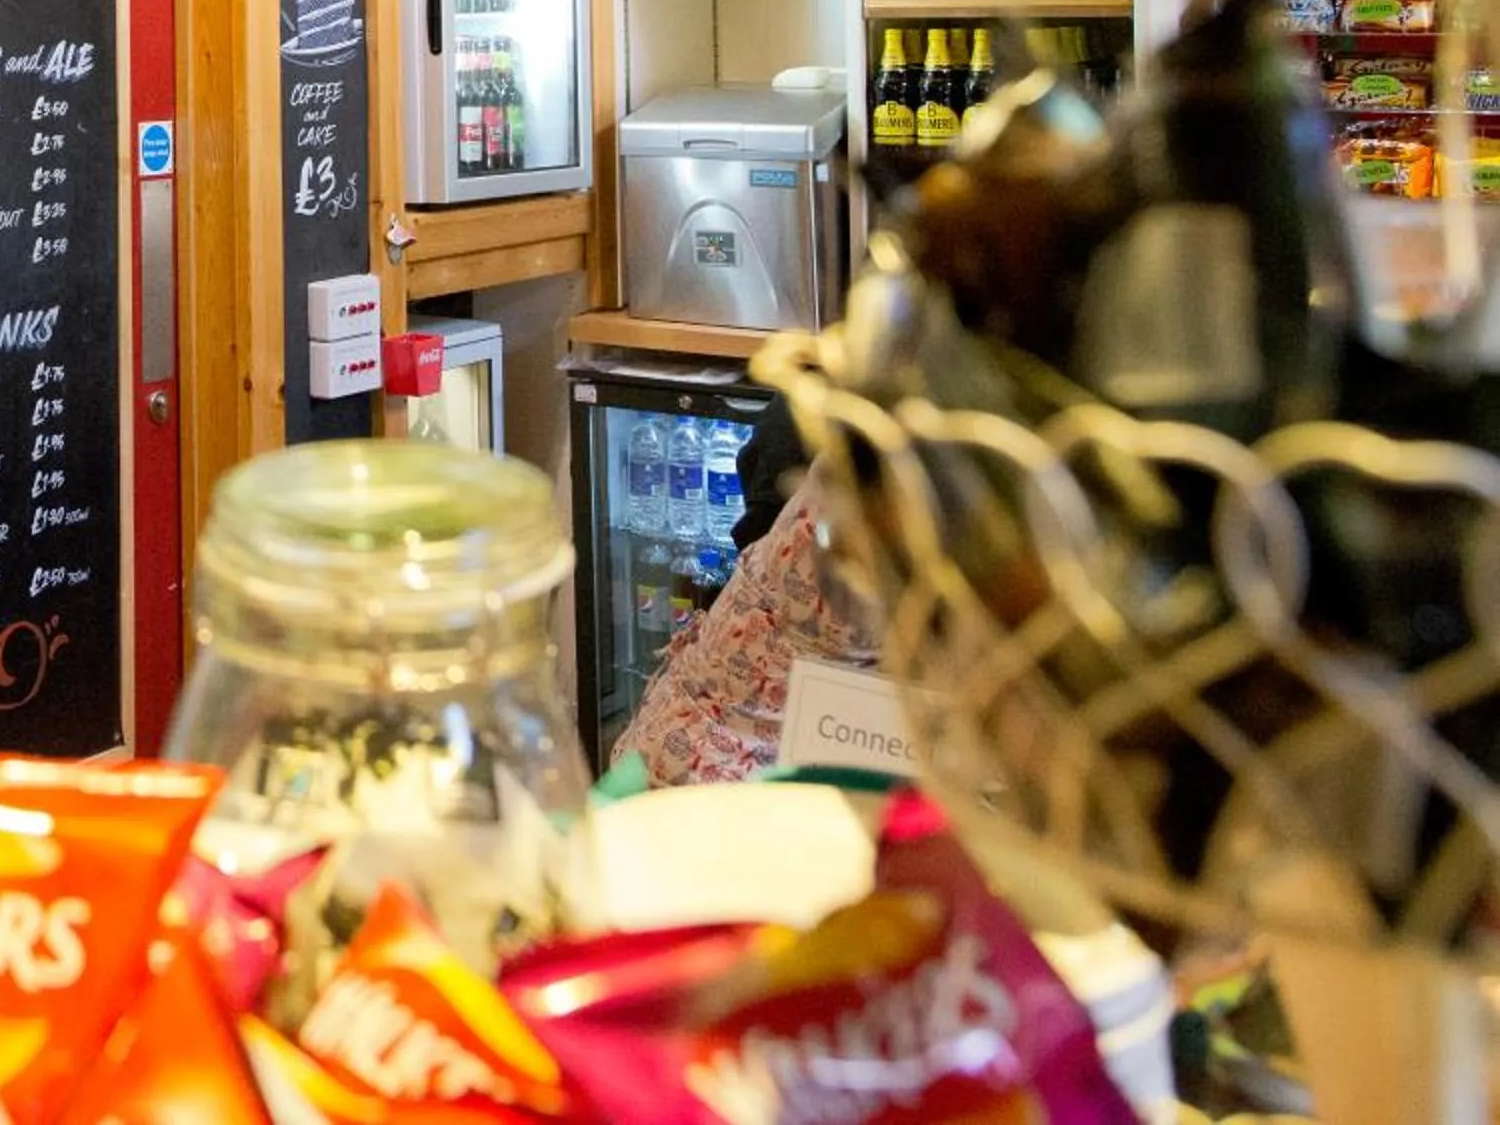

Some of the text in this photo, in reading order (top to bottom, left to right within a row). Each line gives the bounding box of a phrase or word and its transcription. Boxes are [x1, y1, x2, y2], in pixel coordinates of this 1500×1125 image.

[4, 46, 45, 73] and
[43, 40, 96, 85] ALE
[290, 80, 344, 106] COFFEE
[303, 103, 331, 122] and
[297, 123, 338, 147] CAKE
[294, 156, 336, 216] £3
